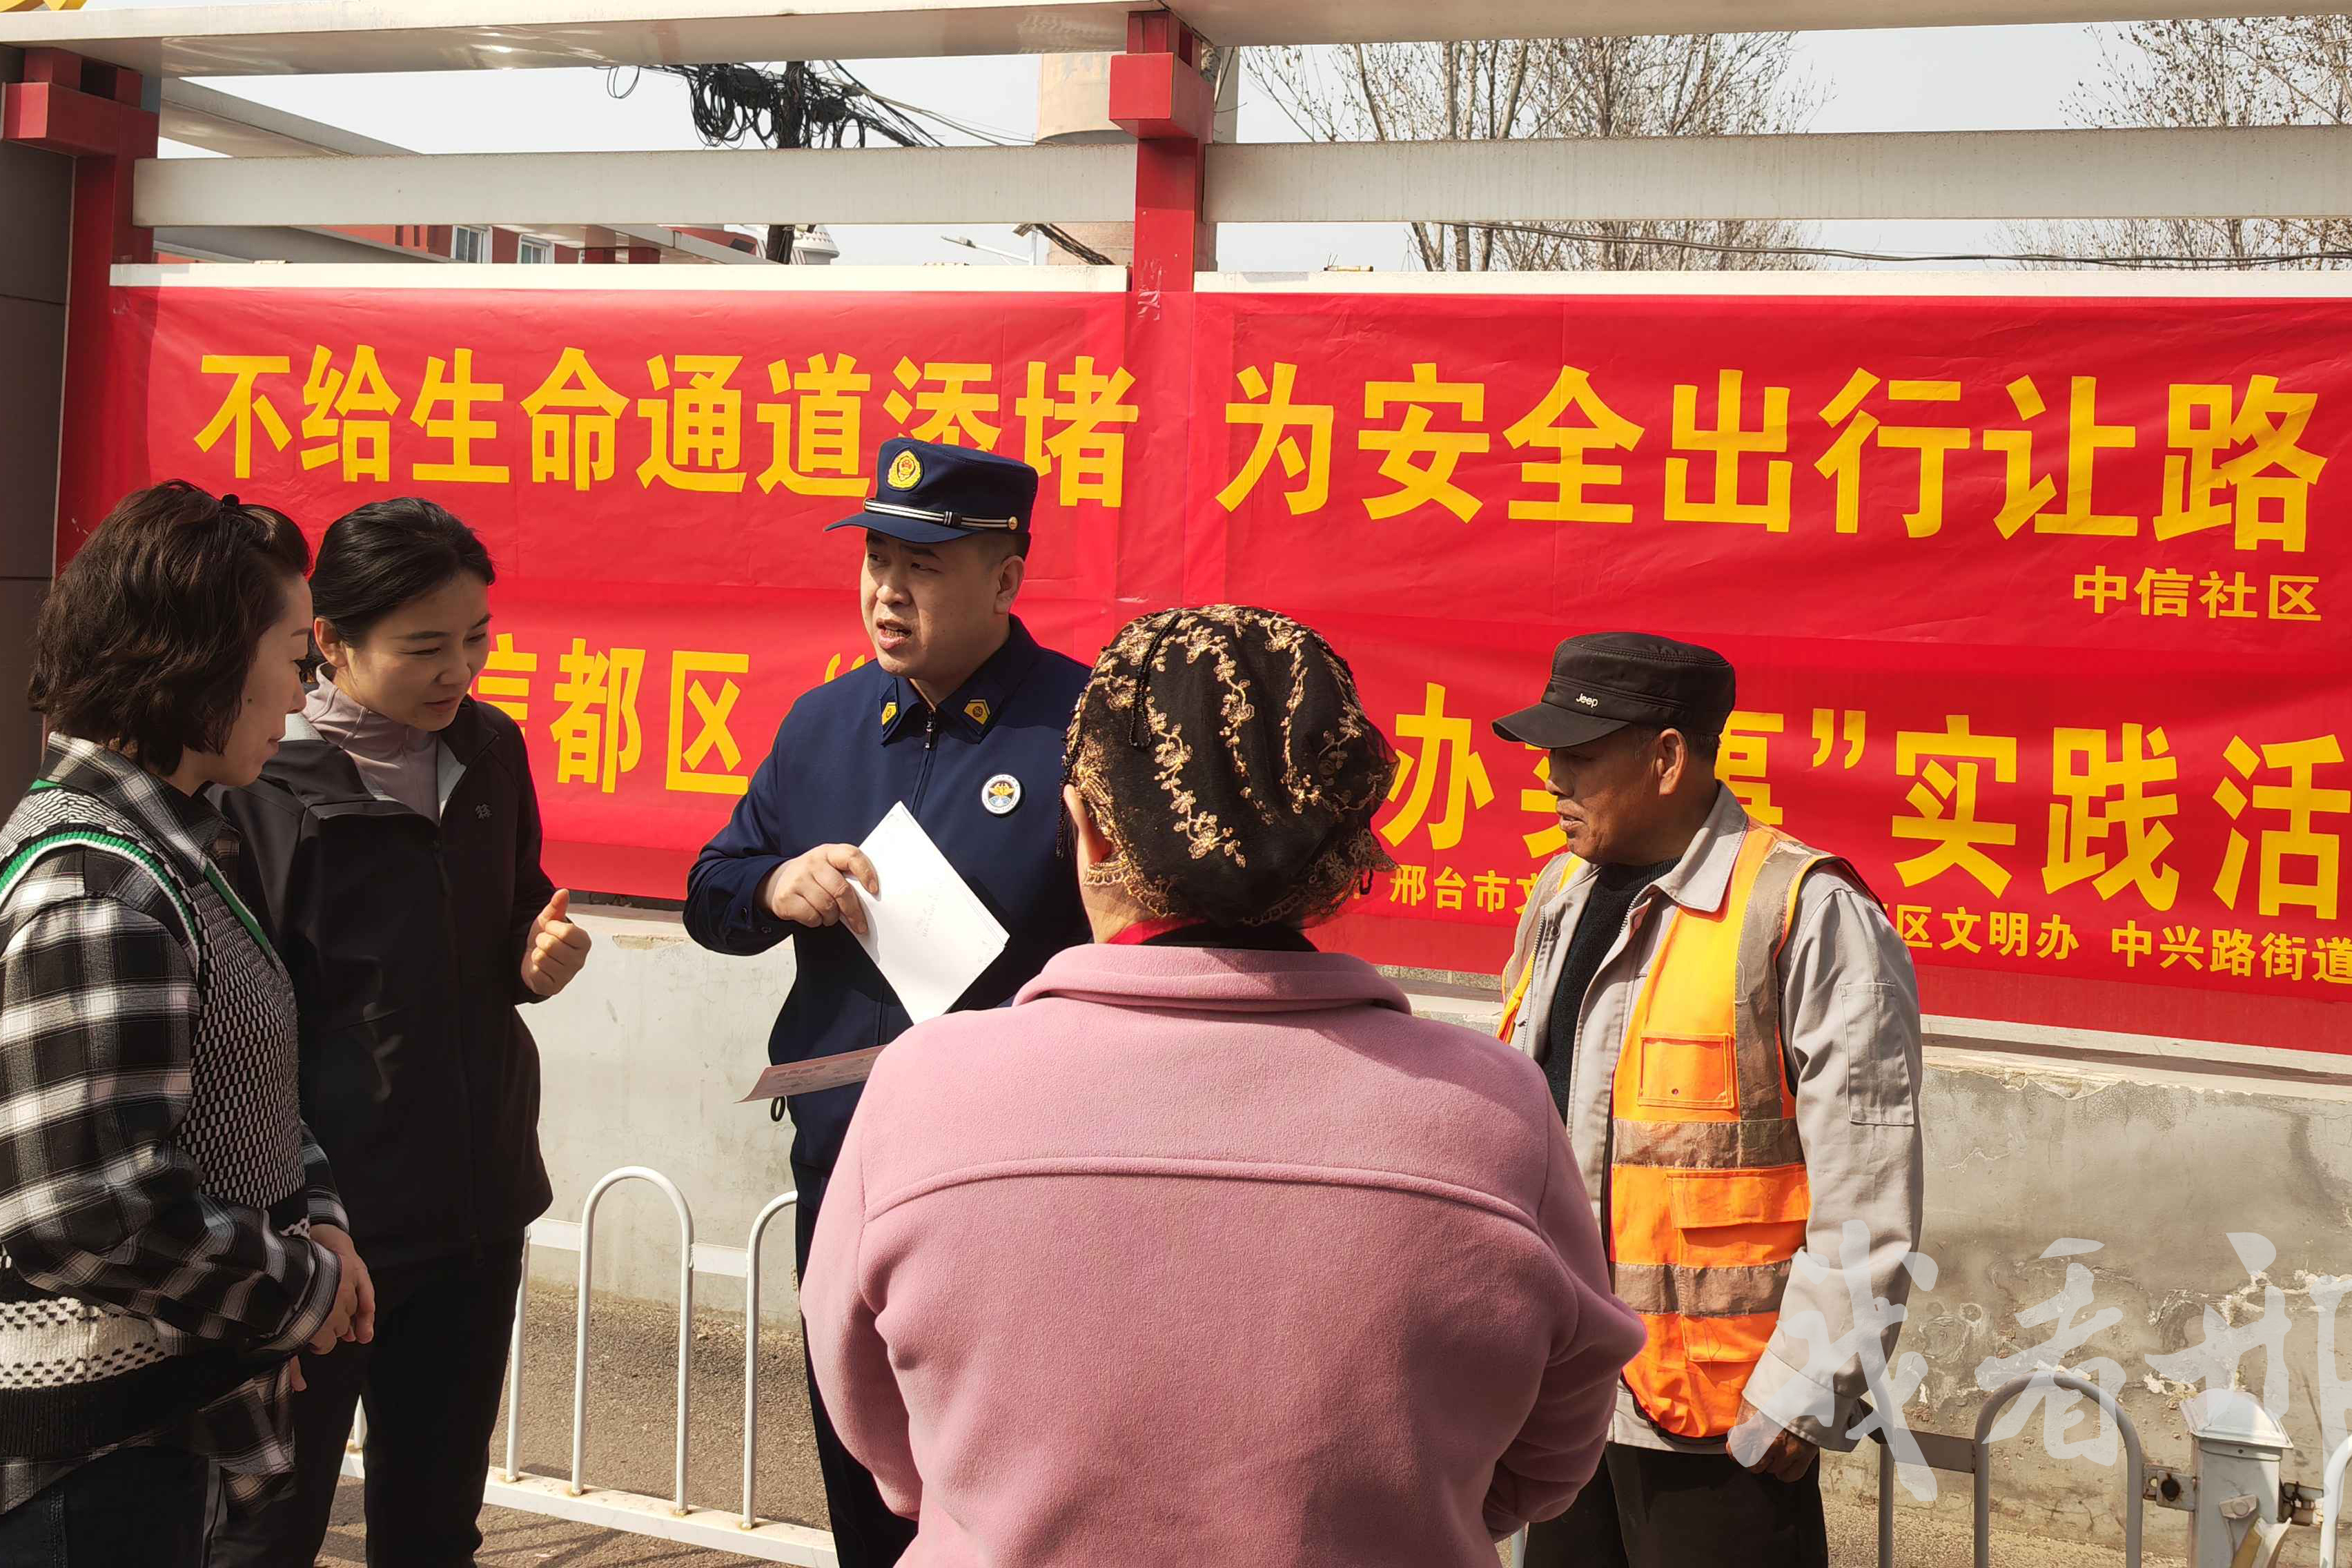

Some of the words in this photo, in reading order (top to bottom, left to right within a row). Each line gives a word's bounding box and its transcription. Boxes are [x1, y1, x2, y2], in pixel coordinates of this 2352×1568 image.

[194, 344, 1139, 508] 不给生命通道添堵
[1215, 362, 2328, 553] 为安全出行让路
[2074, 565, 2322, 620] 中信社区
[1576, 693, 1598, 708] Jeep
[1882, 903, 2079, 960] 区文明办
[2112, 920, 2352, 985] 中兴路街道
